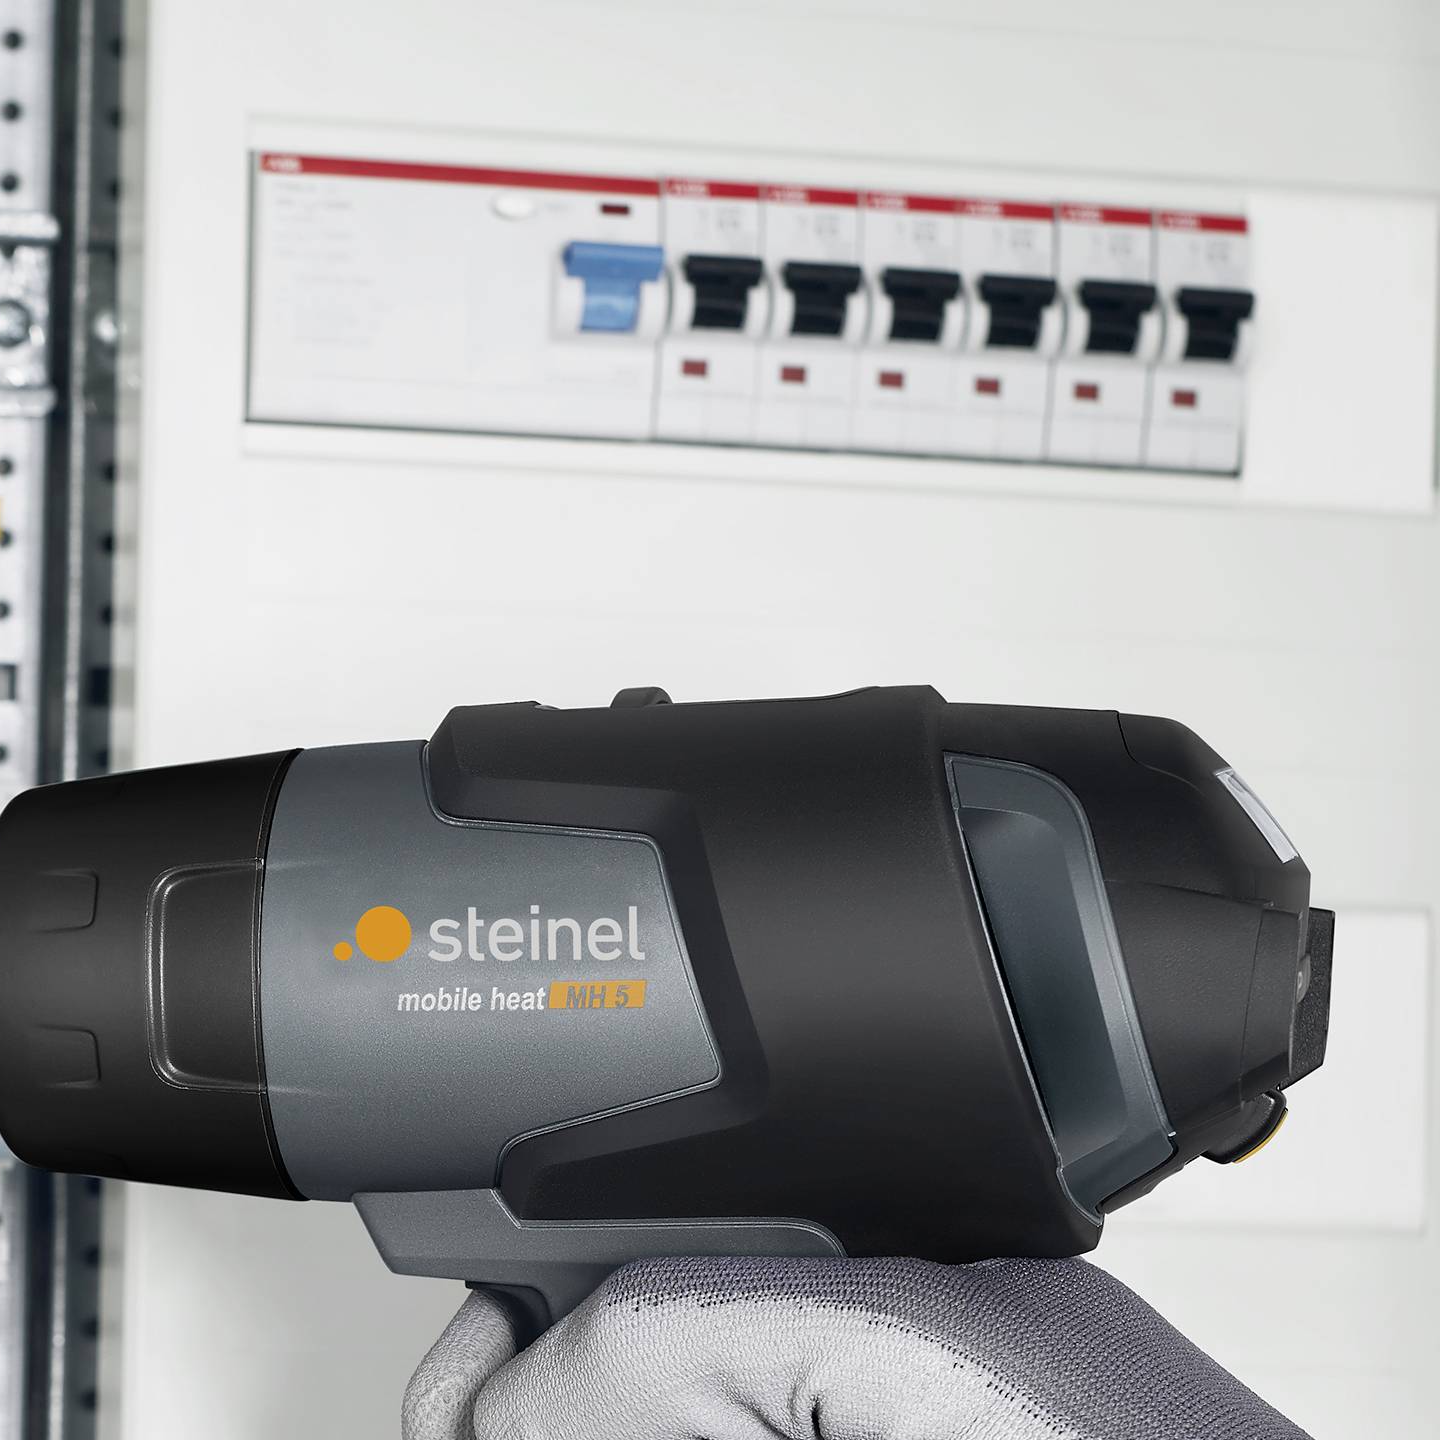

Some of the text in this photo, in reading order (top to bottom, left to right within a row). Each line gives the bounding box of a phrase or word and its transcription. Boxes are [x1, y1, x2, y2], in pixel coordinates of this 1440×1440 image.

[428, 905, 645, 962] steinel
[397, 985, 629, 1011] mobile heat MH 5
